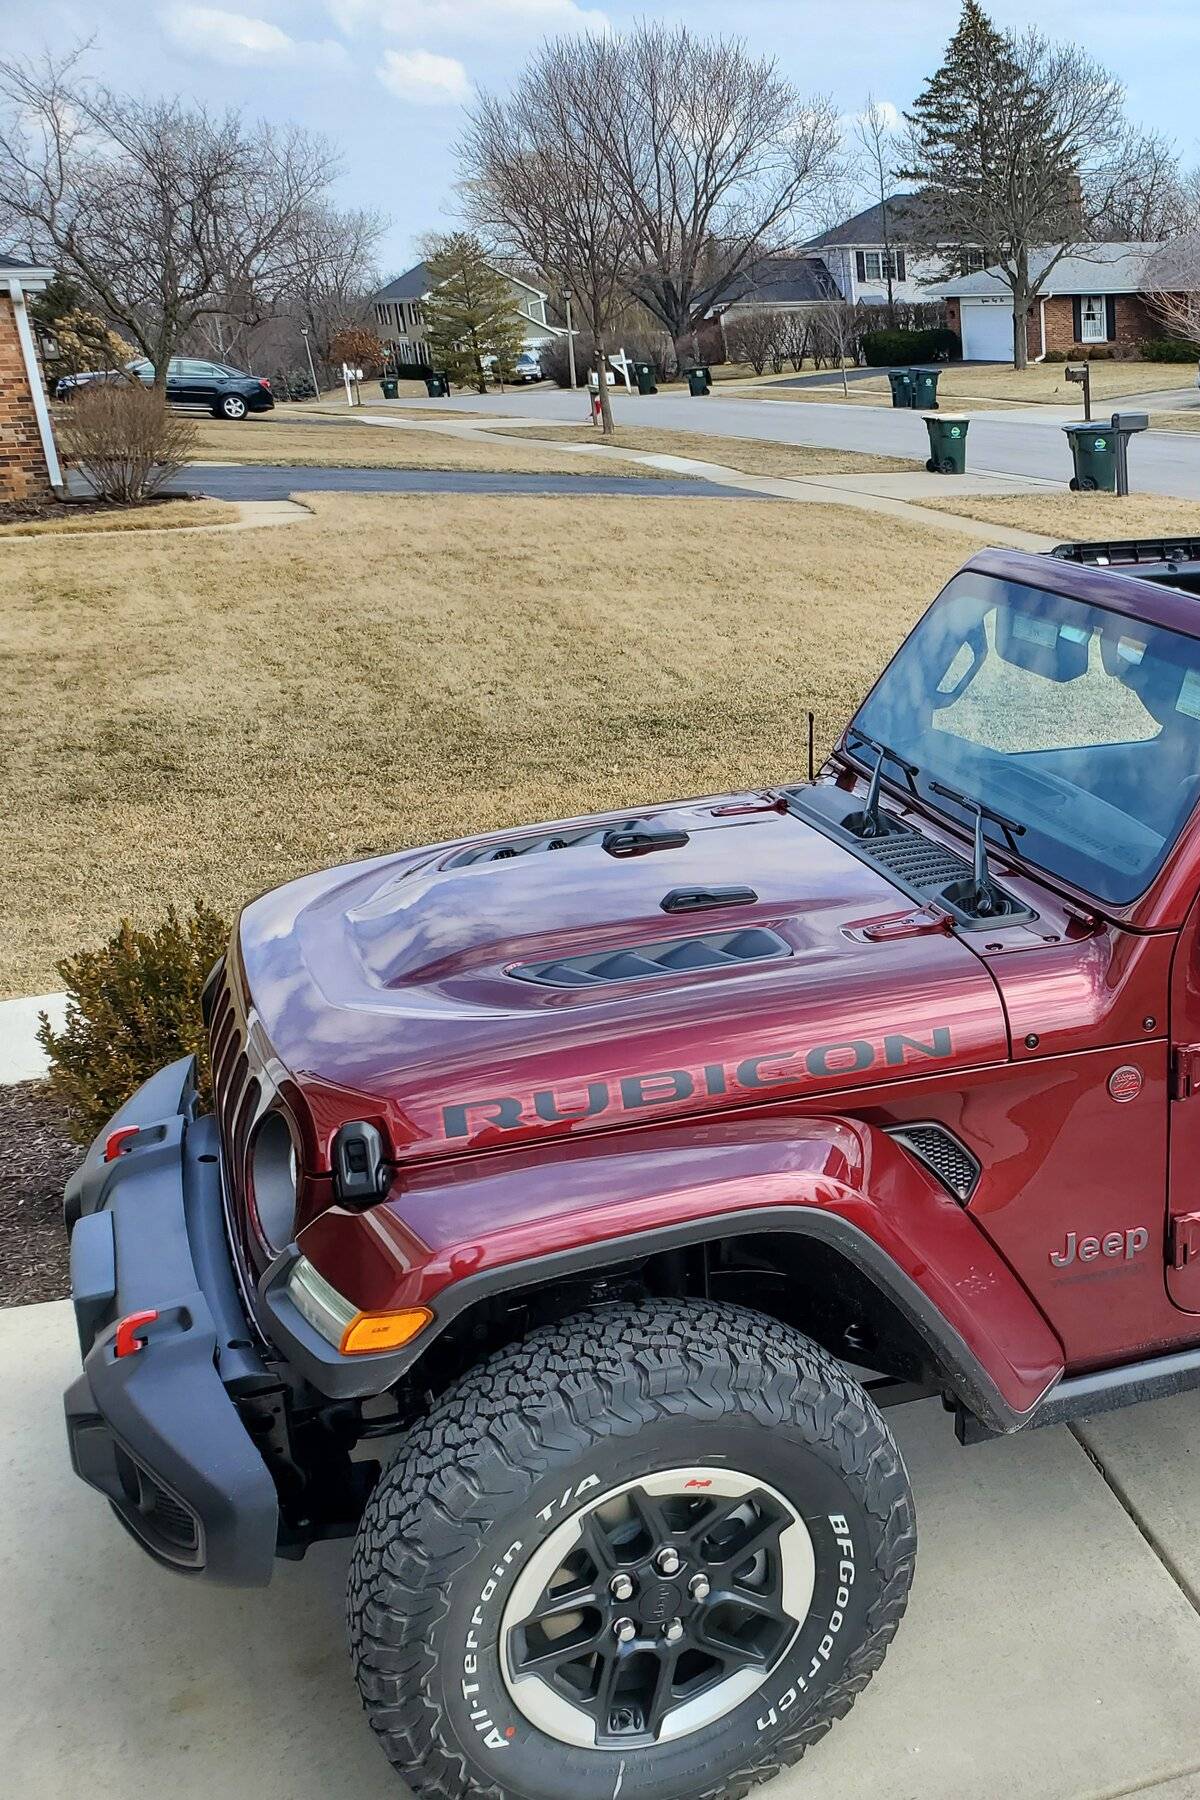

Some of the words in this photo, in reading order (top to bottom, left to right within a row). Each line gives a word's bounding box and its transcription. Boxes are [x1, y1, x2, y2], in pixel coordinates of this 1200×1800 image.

[442, 1026, 952, 1139] RUBICON
[1048, 1226, 1149, 1268] Jeep
[461, 1539, 523, 1749] All-Terrain
[535, 1473, 601, 1522] T/A
[756, 1514, 855, 1731] BFGoodrich
